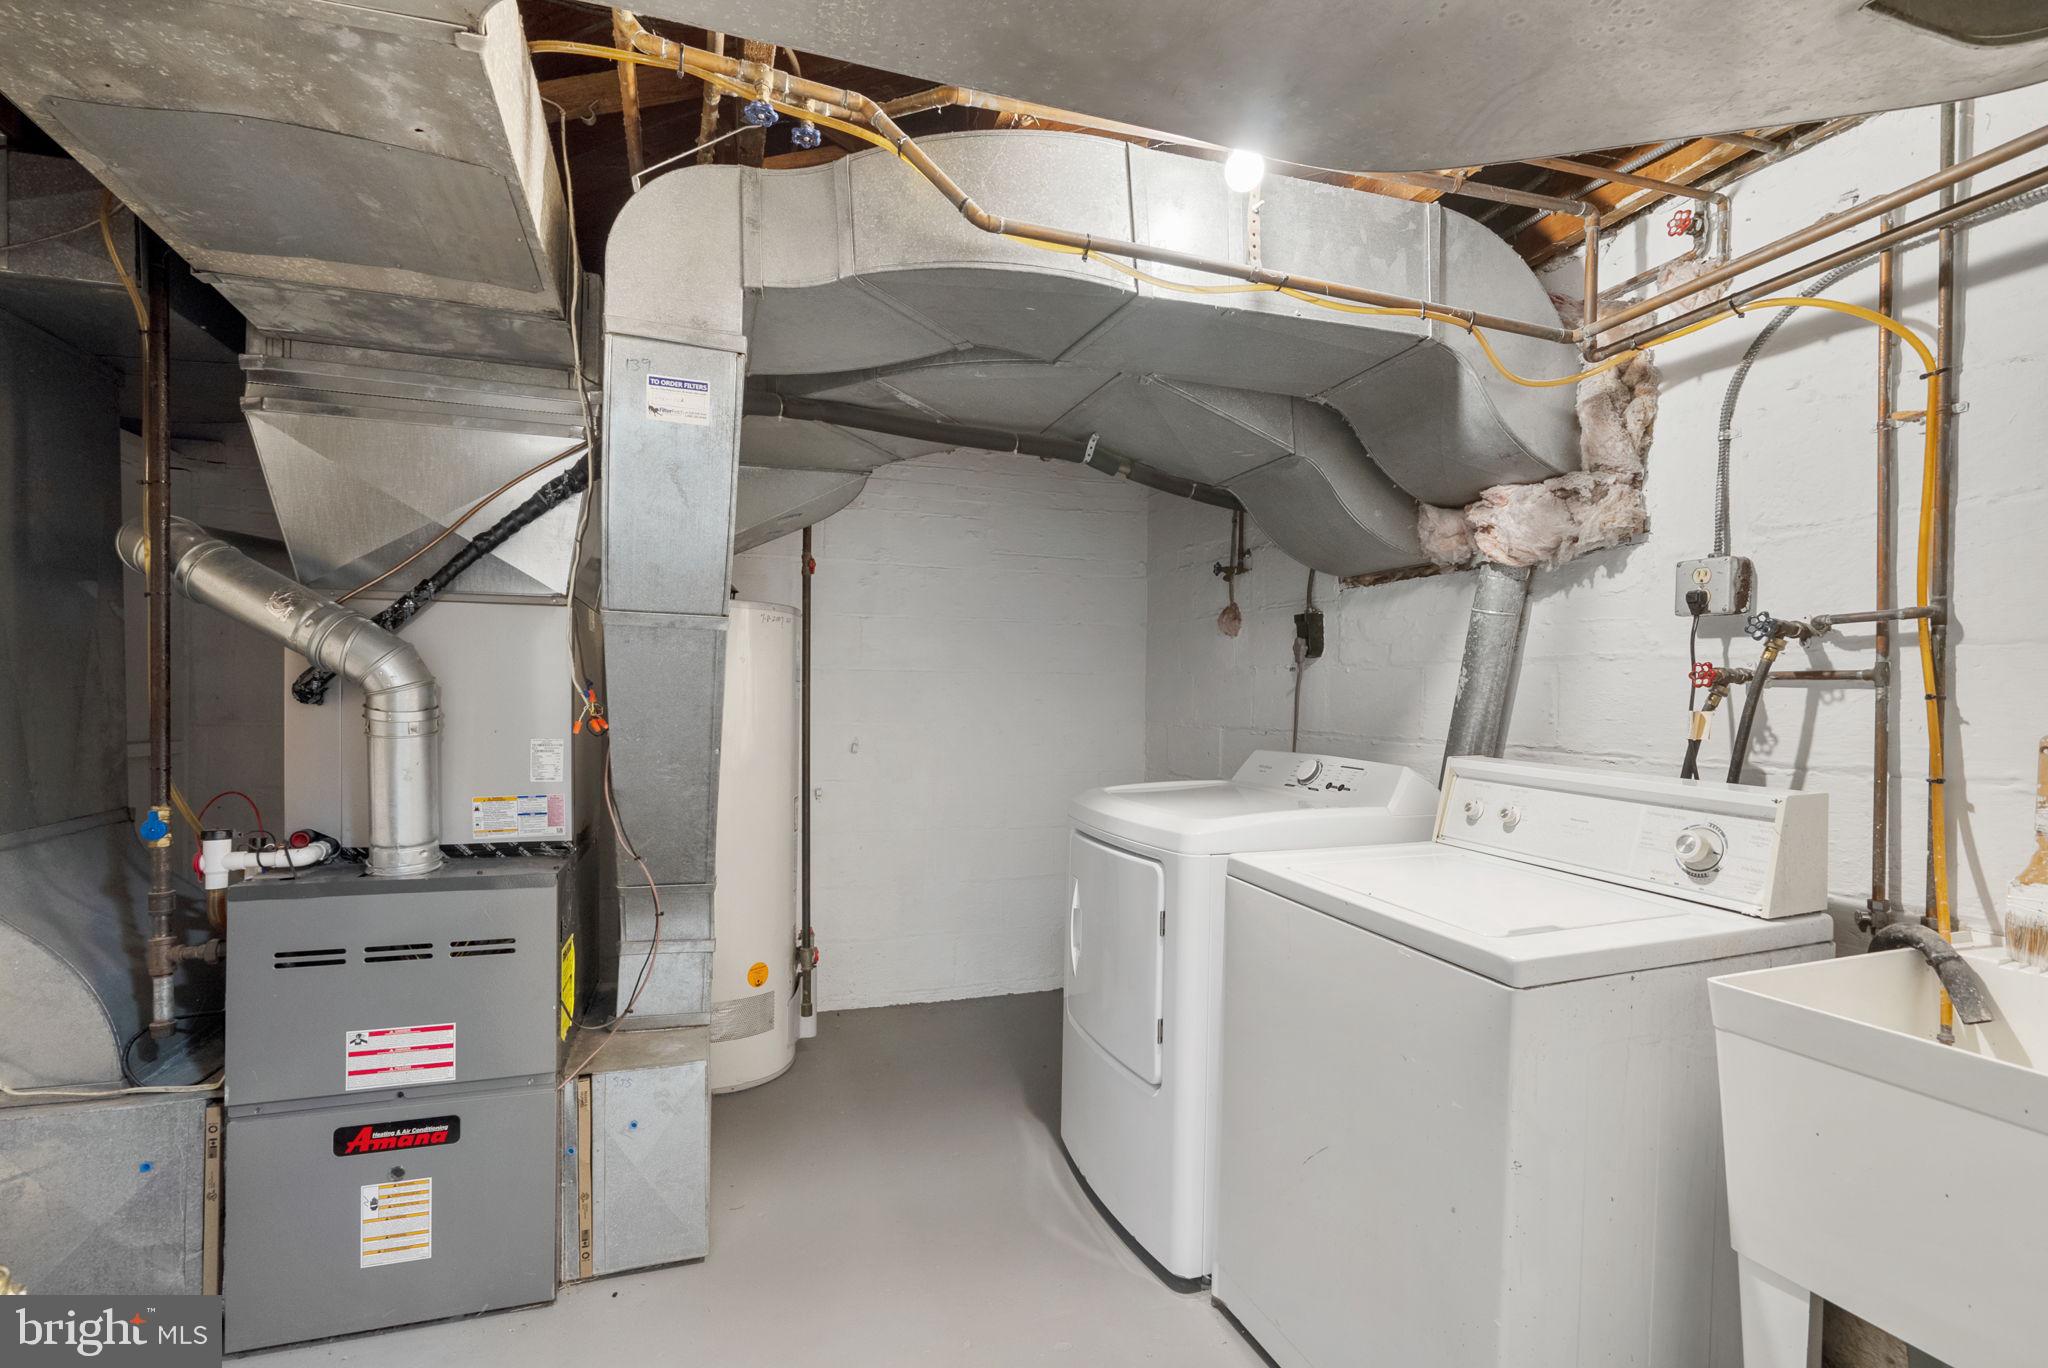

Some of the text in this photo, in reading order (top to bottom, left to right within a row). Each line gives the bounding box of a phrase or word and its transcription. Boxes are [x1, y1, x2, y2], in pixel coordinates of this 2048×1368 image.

[661, 380, 683, 388] ORDER
[684, 382, 707, 391] FILTERS
[372, 1131, 395, 1139] Heating
[412, 1125, 449, 1134] Conditioning
[344, 1126, 449, 1154] Amana
